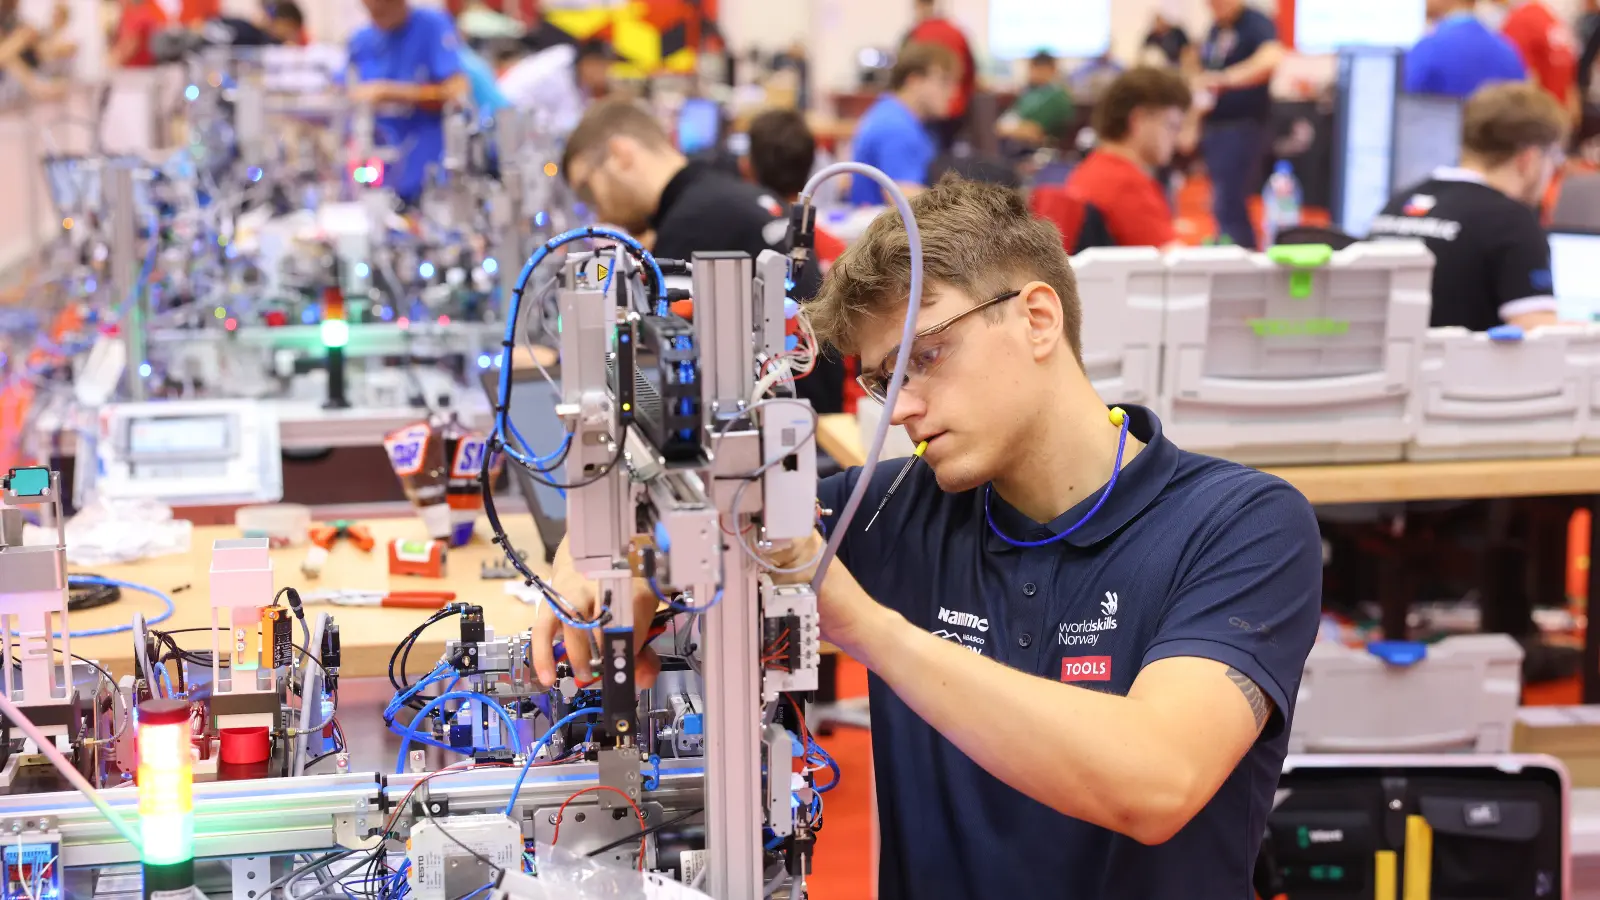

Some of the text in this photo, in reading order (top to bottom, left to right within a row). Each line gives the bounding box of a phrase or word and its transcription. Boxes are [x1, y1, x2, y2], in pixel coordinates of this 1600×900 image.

[938, 606, 989, 632] Nammo
[1060, 616, 1117, 633] worldskills
[1058, 632, 1100, 647] Norway
[1065, 661, 1106, 675] TOOLS
